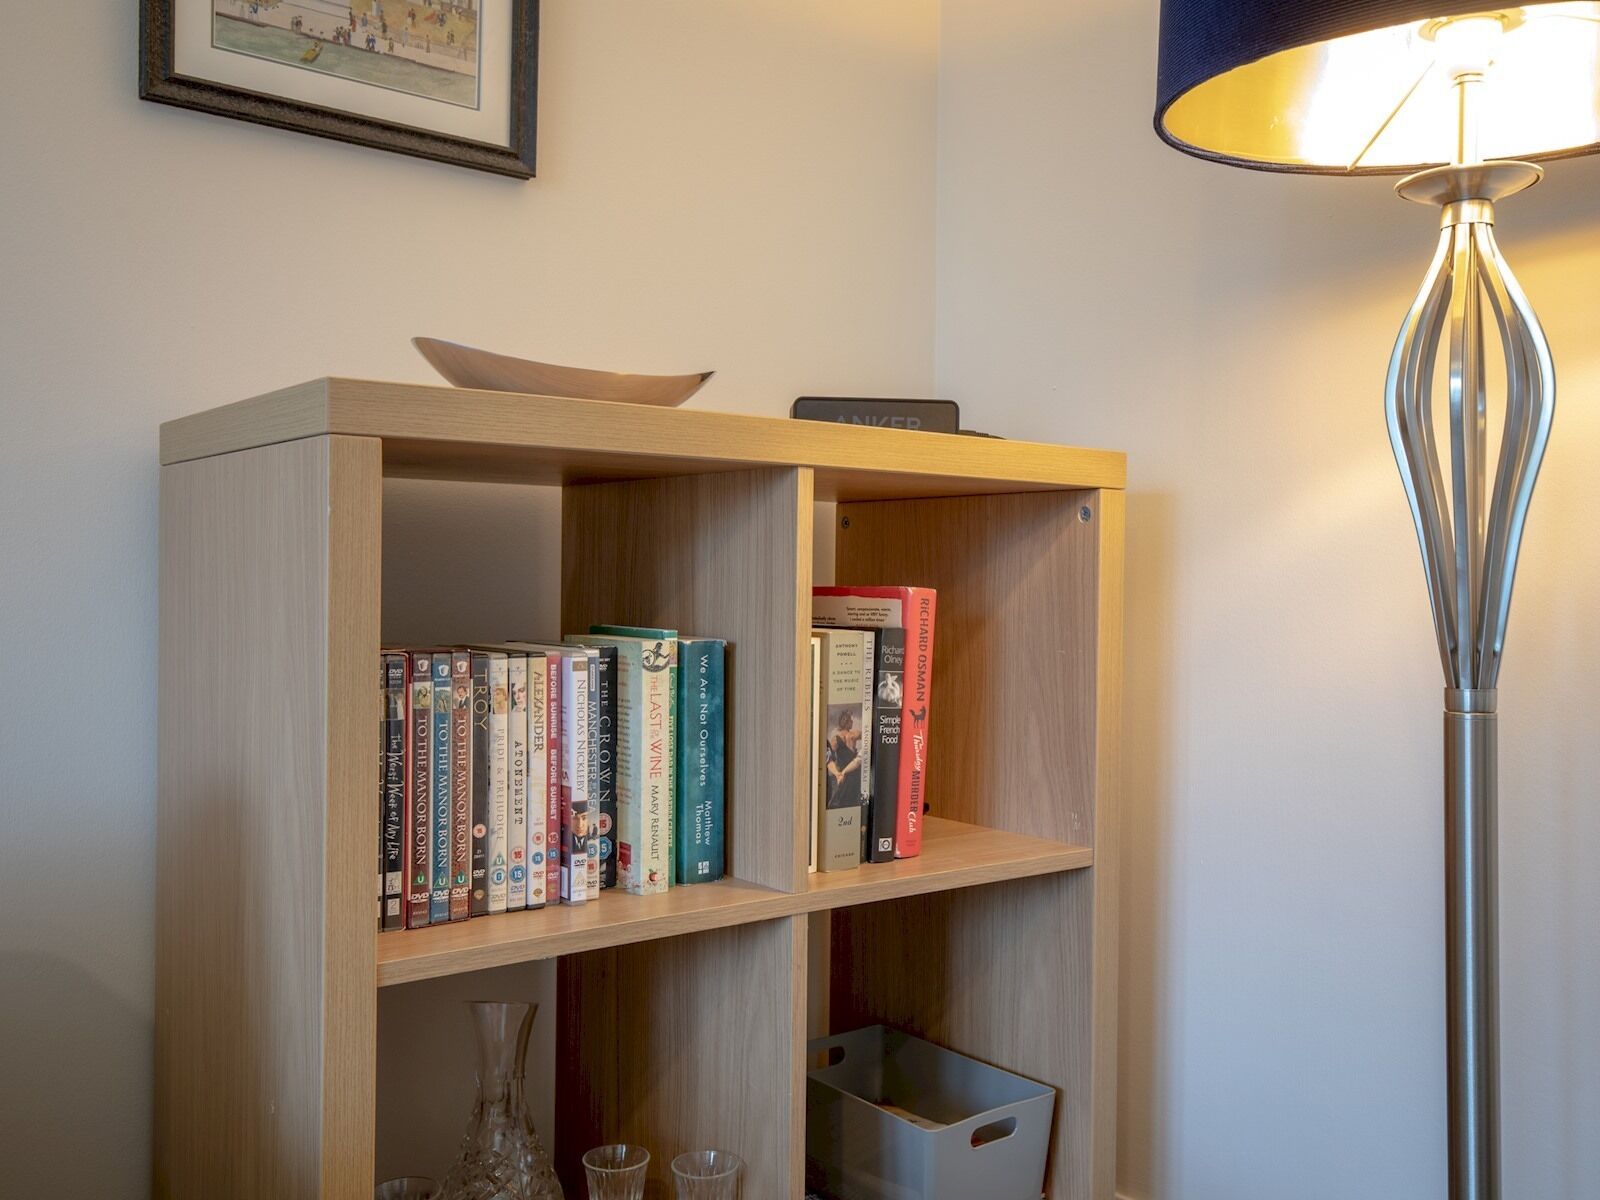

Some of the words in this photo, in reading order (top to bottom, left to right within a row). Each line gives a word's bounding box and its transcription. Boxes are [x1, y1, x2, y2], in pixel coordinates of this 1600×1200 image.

[700, 654, 709, 673] We
[881, 645, 905, 655] Richar
[650, 676, 658, 691] THE
[700, 678, 709, 699] Are
[916, 655, 927, 702] OSMAN
[473, 668, 488, 730] TROY
[576, 679, 586, 736] NICHOLAS
[600, 681, 609, 707] THE
[533, 671, 544, 753] ALEXANDER
[650, 693, 662, 729] LAST
[700, 703, 709, 725] Not
[879, 715, 901, 726] Simple
[417, 715, 428, 737] TO
[438, 719, 449, 741] TO
[456, 715, 467, 737] TO
[587, 701, 598, 780] MANCHESTER
[879, 726, 900, 734] French
[881, 735, 899, 744] Food
[386, 749, 404, 781] Worst
[417, 739, 428, 768] THE
[438, 743, 449, 772] THE
[456, 739, 467, 767] THE
[576, 740, 586, 792] NICKLEBY
[599, 715, 612, 802] CROWN
[649, 738, 662, 779] WINE
[699, 729, 709, 787] Ourselves
[386, 780, 405, 809] Week
[416, 770, 427, 824] MANOR
[456, 770, 467, 822] MANOR
[514, 740, 524, 825] ATONEMENT
[909, 770, 920, 813] MURDER
[437, 774, 448, 829] MANOR
[496, 780, 505, 840] PREJUDICE
[649, 784, 660, 816] MARY
[385, 823, 401, 840] My
[388, 811, 399, 823] of
[695, 804, 704, 845] Thomas
[704, 800, 714, 846] Matthew
[838, 816, 853, 827] 2nd
[907, 811, 917, 833] Club
[416, 826, 427, 865] BORN
[437, 829, 448, 868] BORN
[456, 824, 467, 862] BORN
[650, 818, 660, 861] RENAULT
[514, 850, 522, 859] 15
[514, 870, 522, 878] 15
[411, 892, 430, 900] DVD
[433, 889, 450, 897] DVD
[452, 886, 469, 894] DVD
